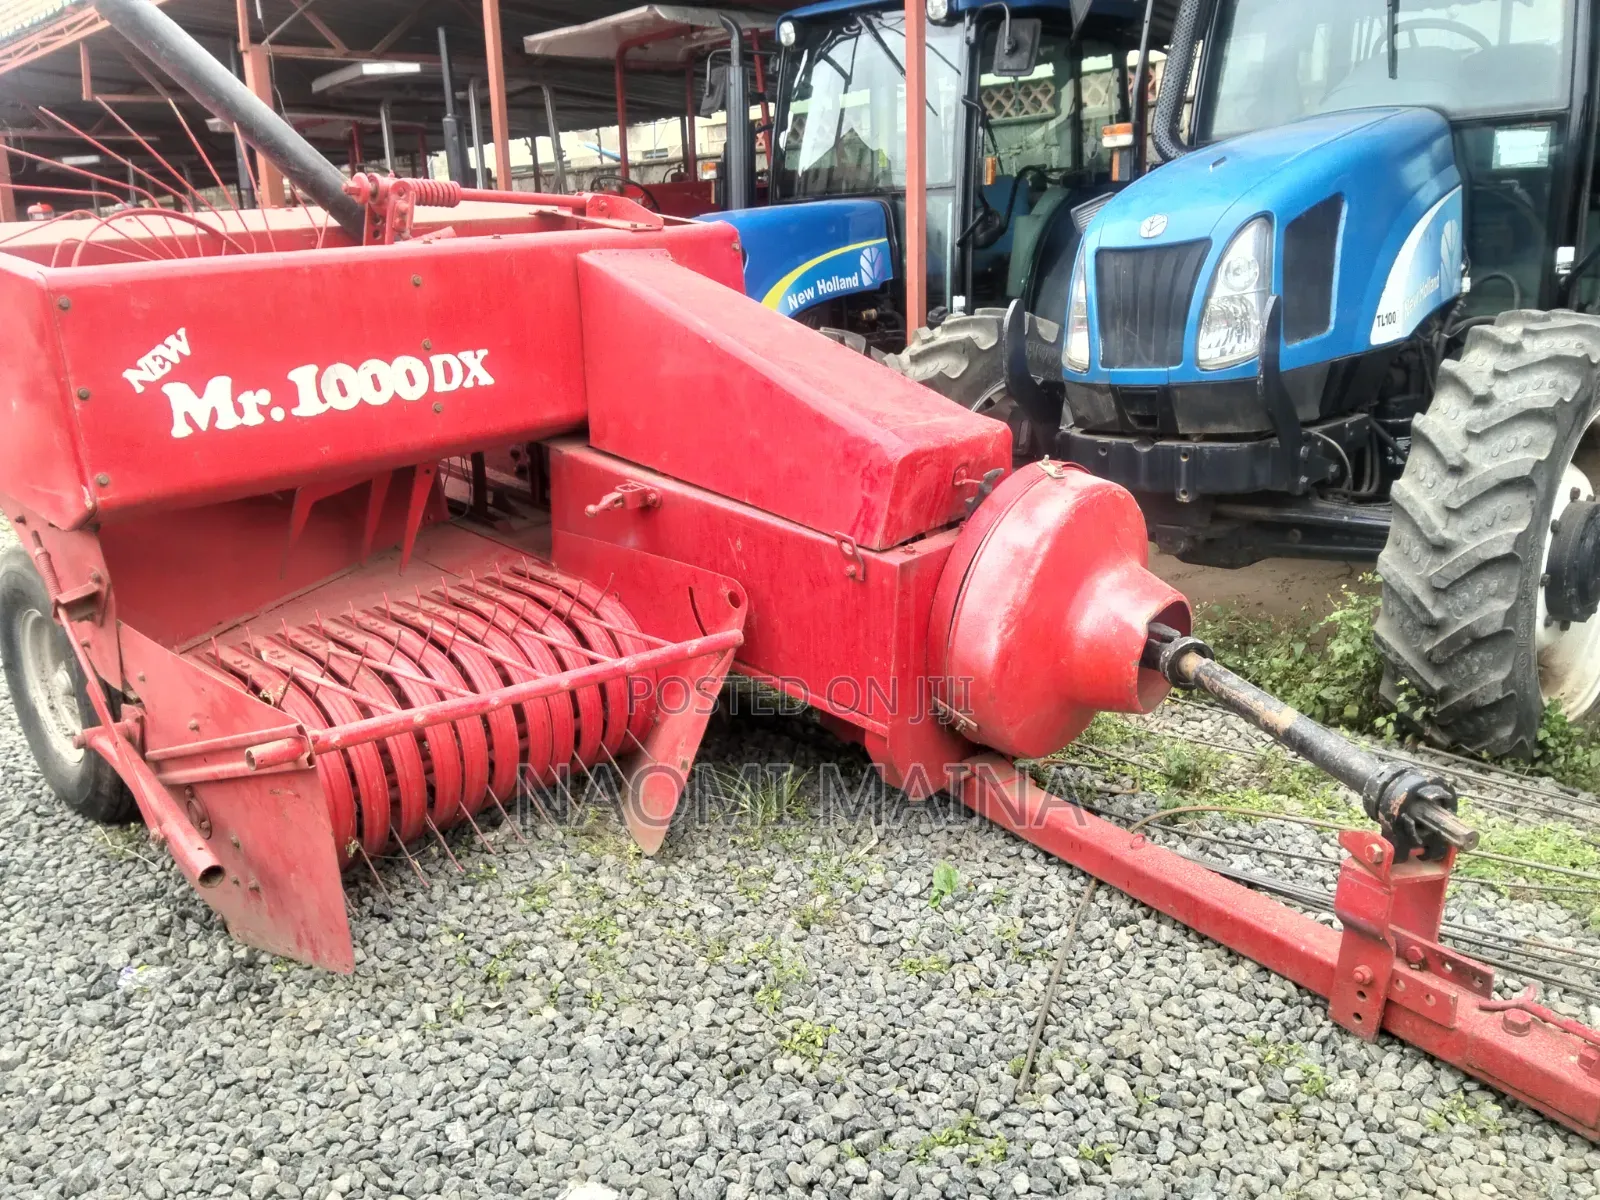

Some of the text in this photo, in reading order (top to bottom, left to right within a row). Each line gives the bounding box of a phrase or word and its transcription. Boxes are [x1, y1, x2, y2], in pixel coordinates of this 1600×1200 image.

[788, 272, 859, 310] New Holland
[1377, 311, 1396, 327] TL100
[122, 327, 191, 393] NEW
[161, 375, 285, 438] Mr.
